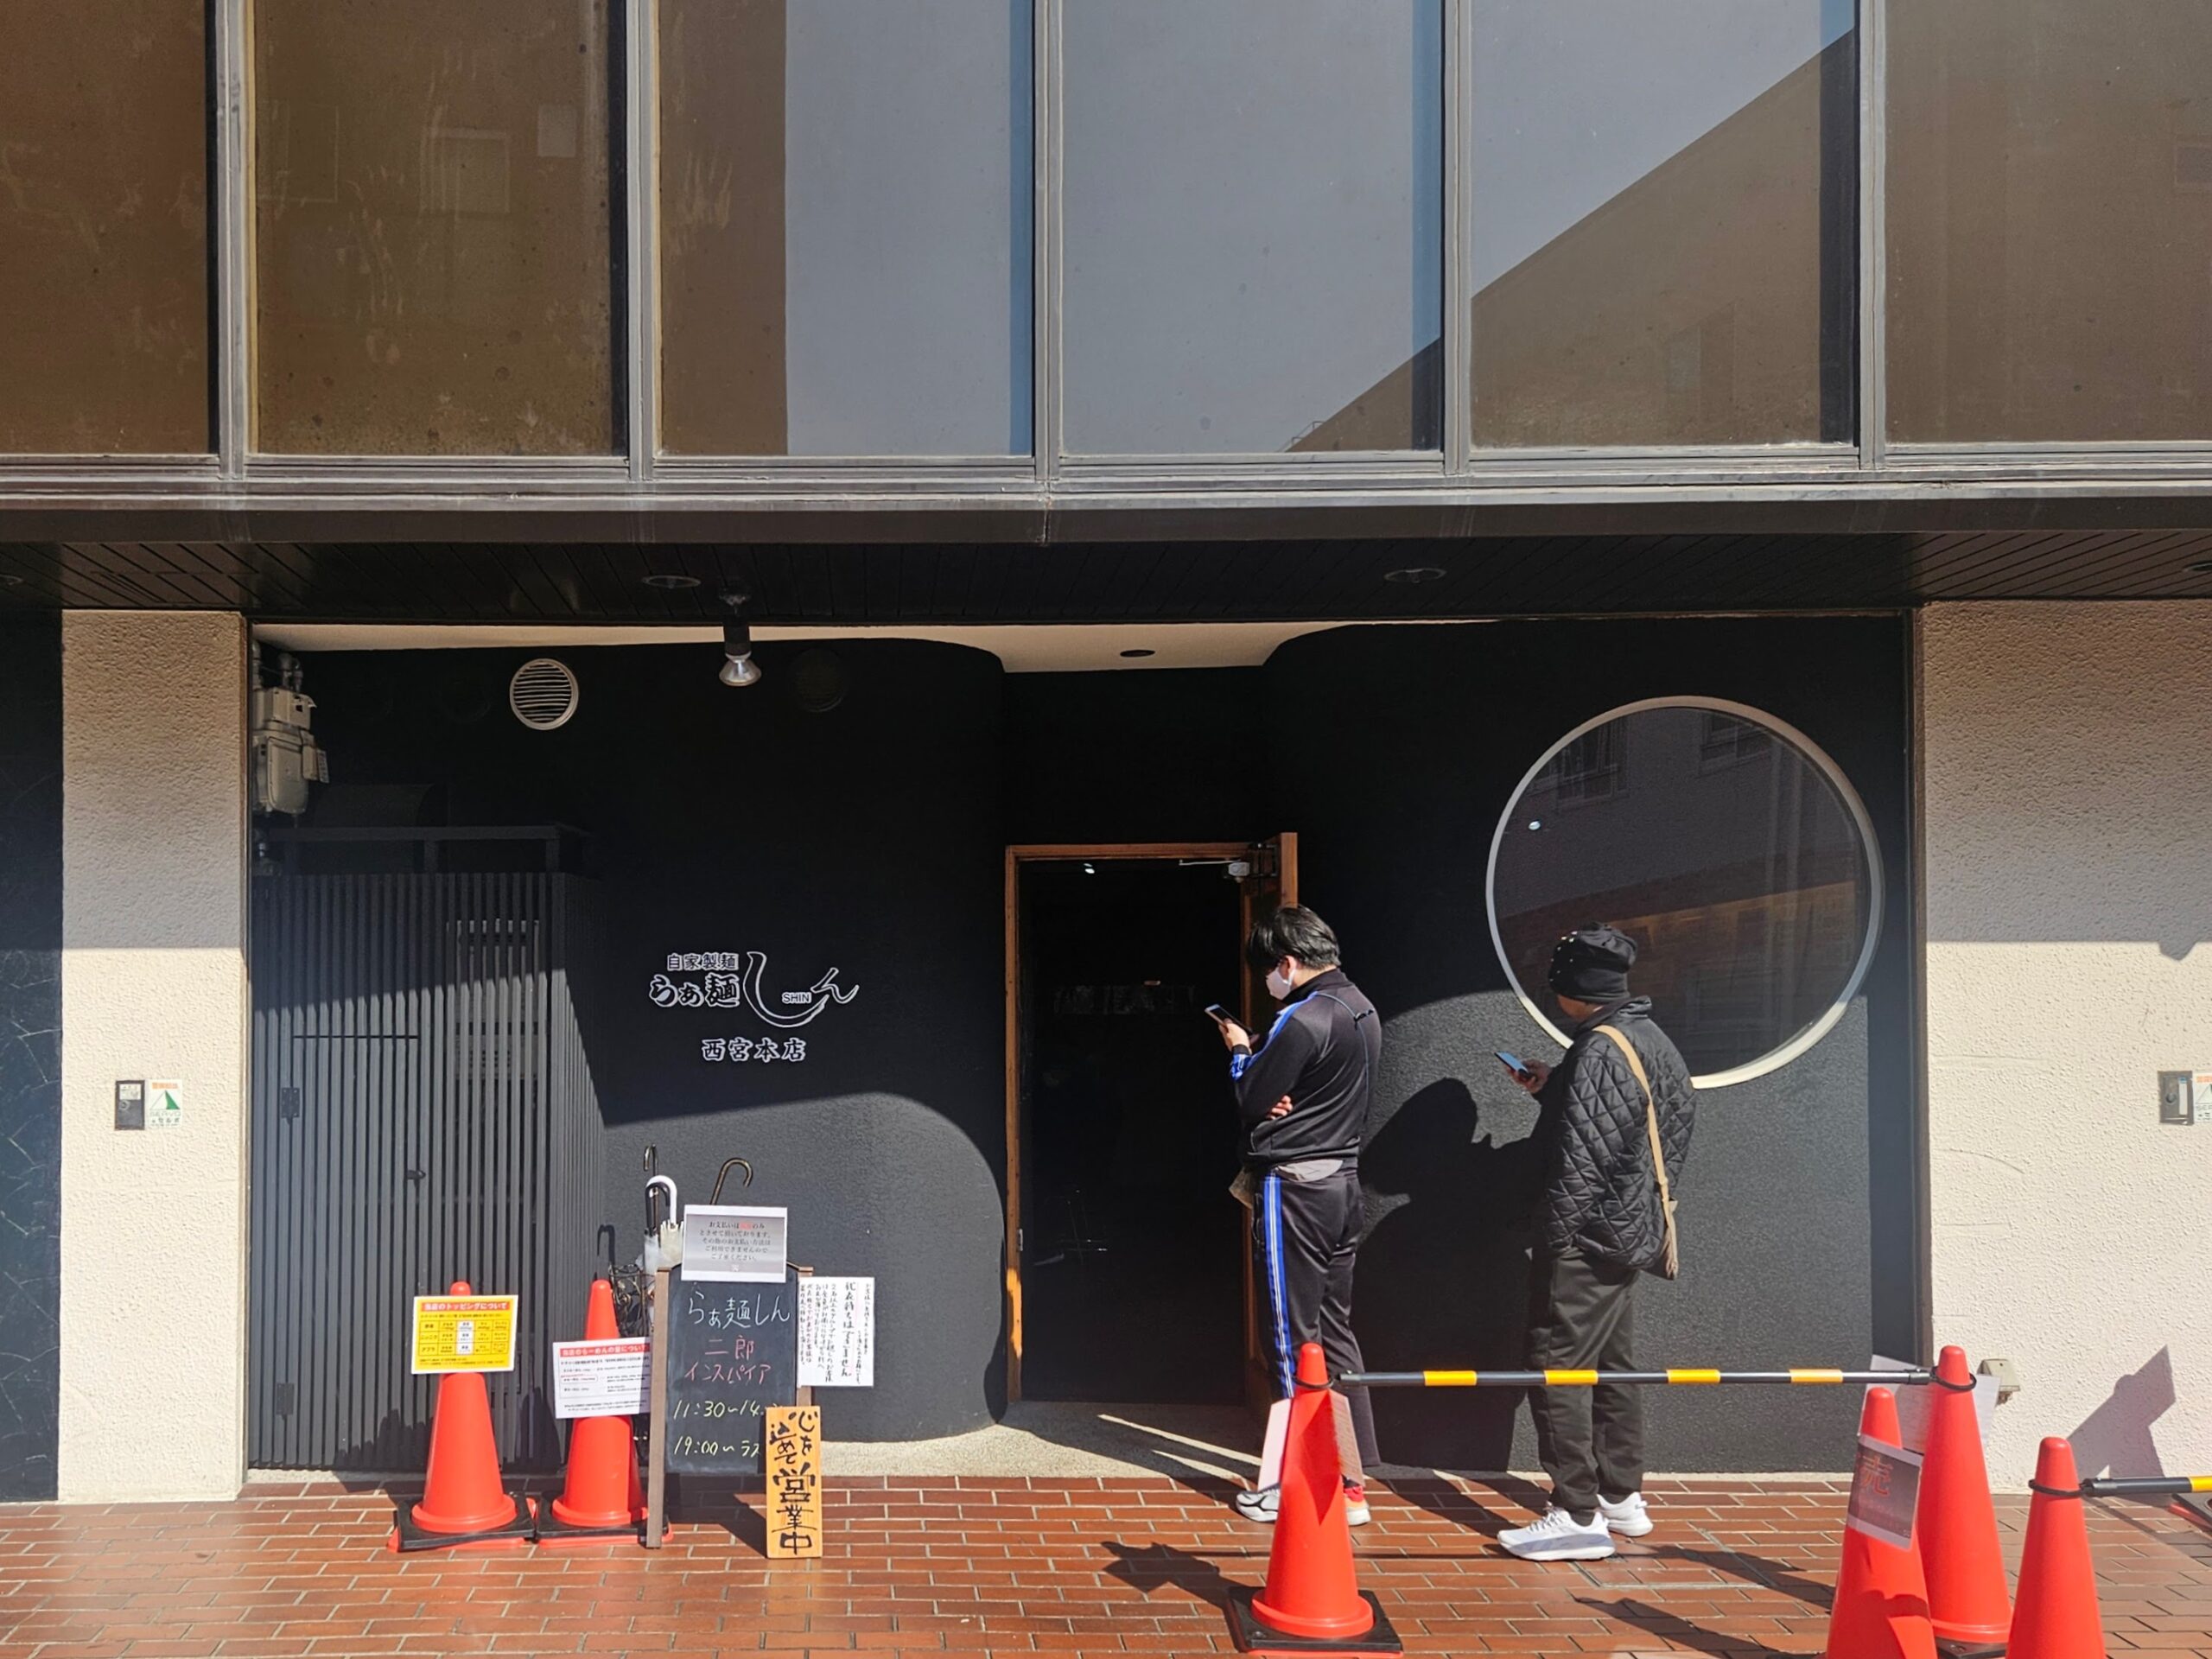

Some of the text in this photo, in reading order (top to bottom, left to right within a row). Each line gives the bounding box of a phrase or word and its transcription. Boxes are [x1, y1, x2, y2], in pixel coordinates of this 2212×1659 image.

[667, 952, 739, 971] 自家製麺
[649, 972, 740, 1007] らぁ麺
[782, 993, 812, 1004] SHIN
[702, 1037, 806, 1062] 西宮本店
[709, 1221, 765, 1230] お支払いはのみ
[688, 1291, 791, 1330] らぁ麺しん
[705, 1334, 754, 1361] 二郎
[684, 1362, 772, 1384] インスパイア
[772, 1462, 818, 1554] 営業中
